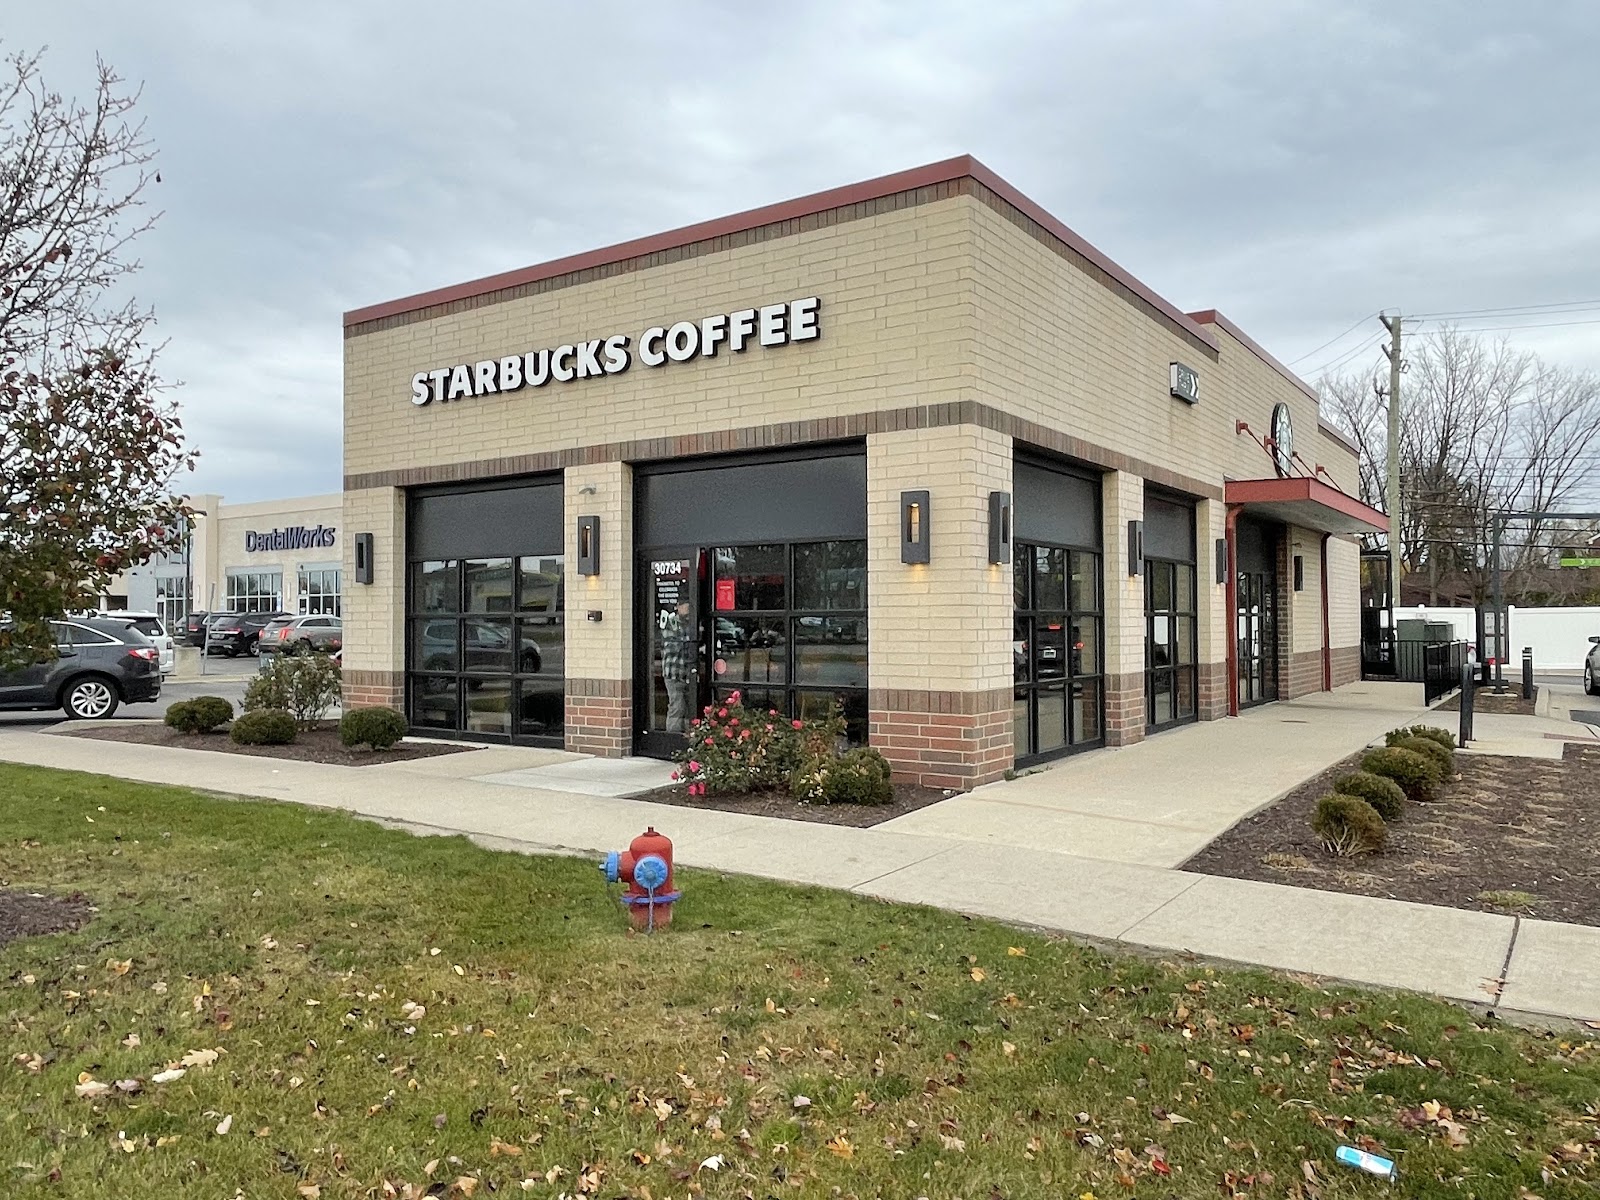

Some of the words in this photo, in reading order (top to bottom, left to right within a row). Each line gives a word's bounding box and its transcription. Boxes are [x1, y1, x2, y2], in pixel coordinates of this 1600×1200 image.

[411, 334, 629, 406] STARBUCKS
[638, 297, 820, 366] COFFEE
[245, 524, 336, 552] DentalWorks
[654, 561, 681, 575] 30734
